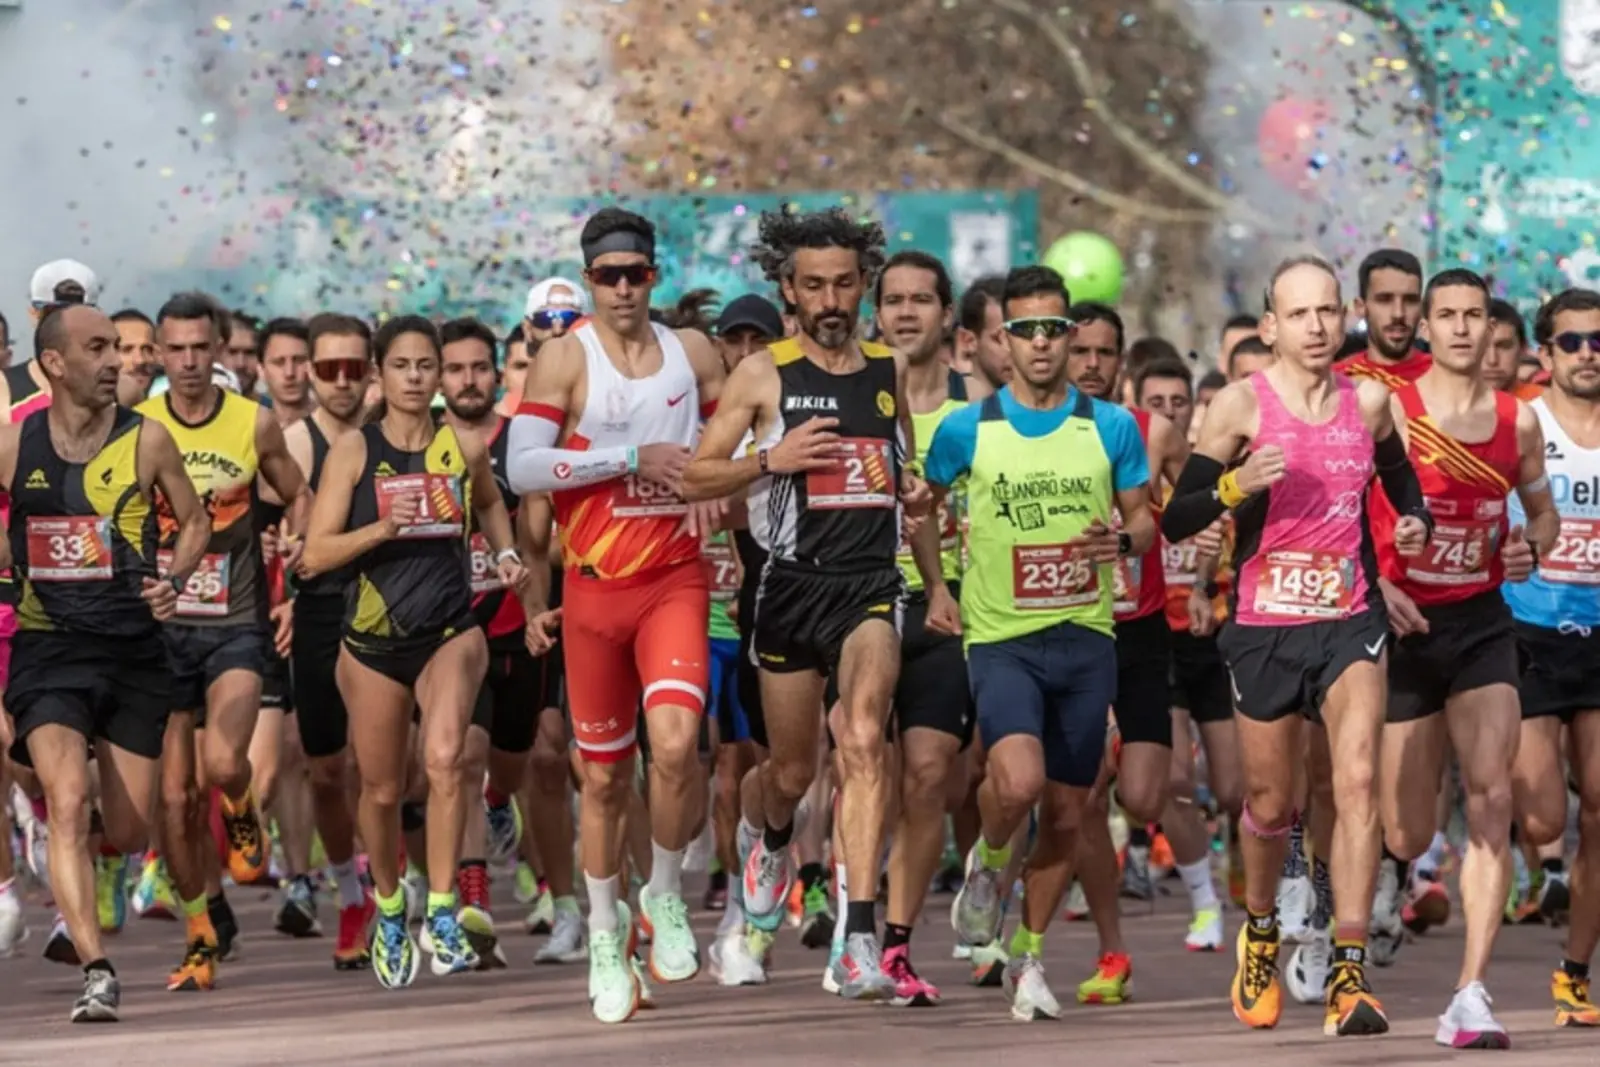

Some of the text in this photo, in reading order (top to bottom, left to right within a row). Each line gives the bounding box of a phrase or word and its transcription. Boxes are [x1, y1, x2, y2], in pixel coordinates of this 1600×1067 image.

[844, 458, 865, 484] 2
[991, 477, 1092, 502] ALEJANDRO SANZ
[416, 491, 428, 517] 1
[48, 535, 84, 561] 33
[1432, 540, 1483, 566] 745
[1021, 559, 1091, 589] 2325
[1270, 566, 1341, 599] 1492
